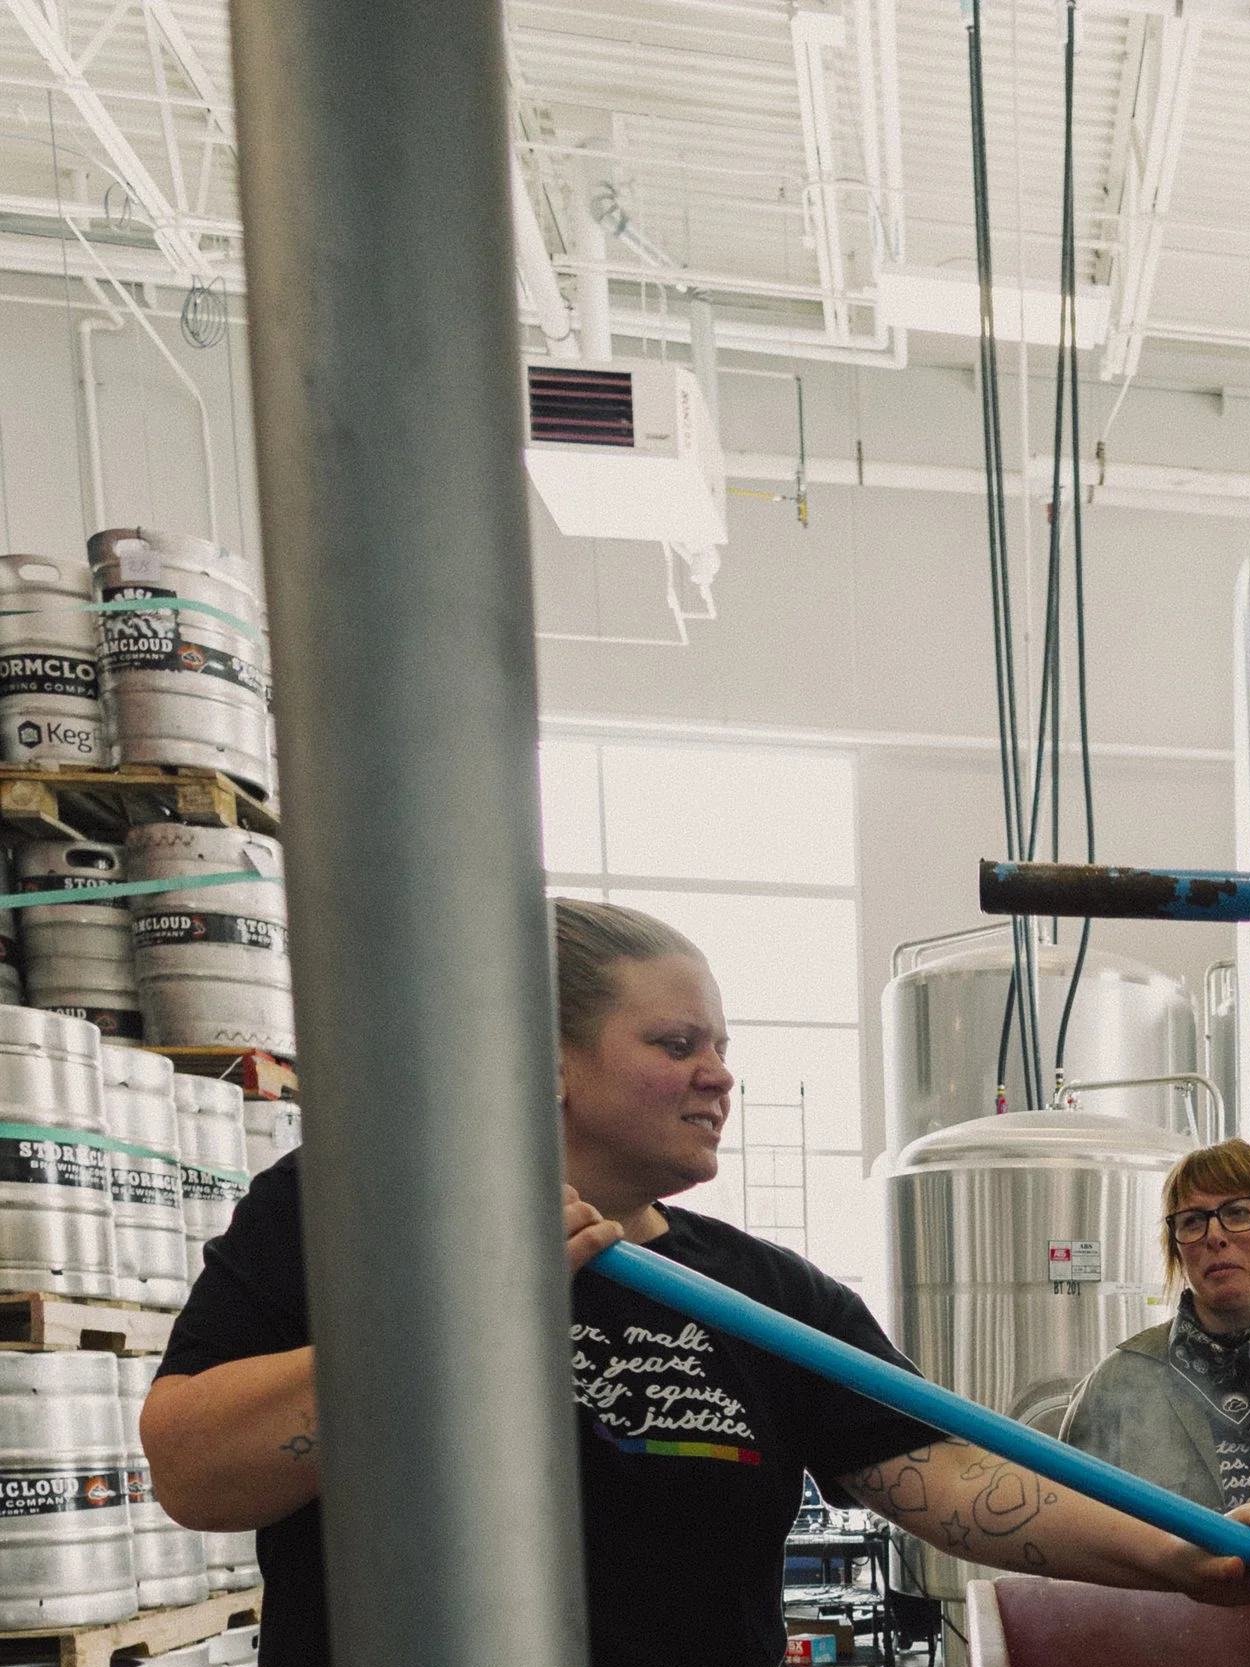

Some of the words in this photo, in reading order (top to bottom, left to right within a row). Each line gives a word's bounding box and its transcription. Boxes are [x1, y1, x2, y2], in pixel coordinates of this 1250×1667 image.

[1067, 1281, 1081, 1296] 201
[624, 1323, 714, 1352] malt.
[603, 1355, 706, 1378] yeast.
[645, 1380, 746, 1416] equity.
[627, 1406, 755, 1440] justice.
